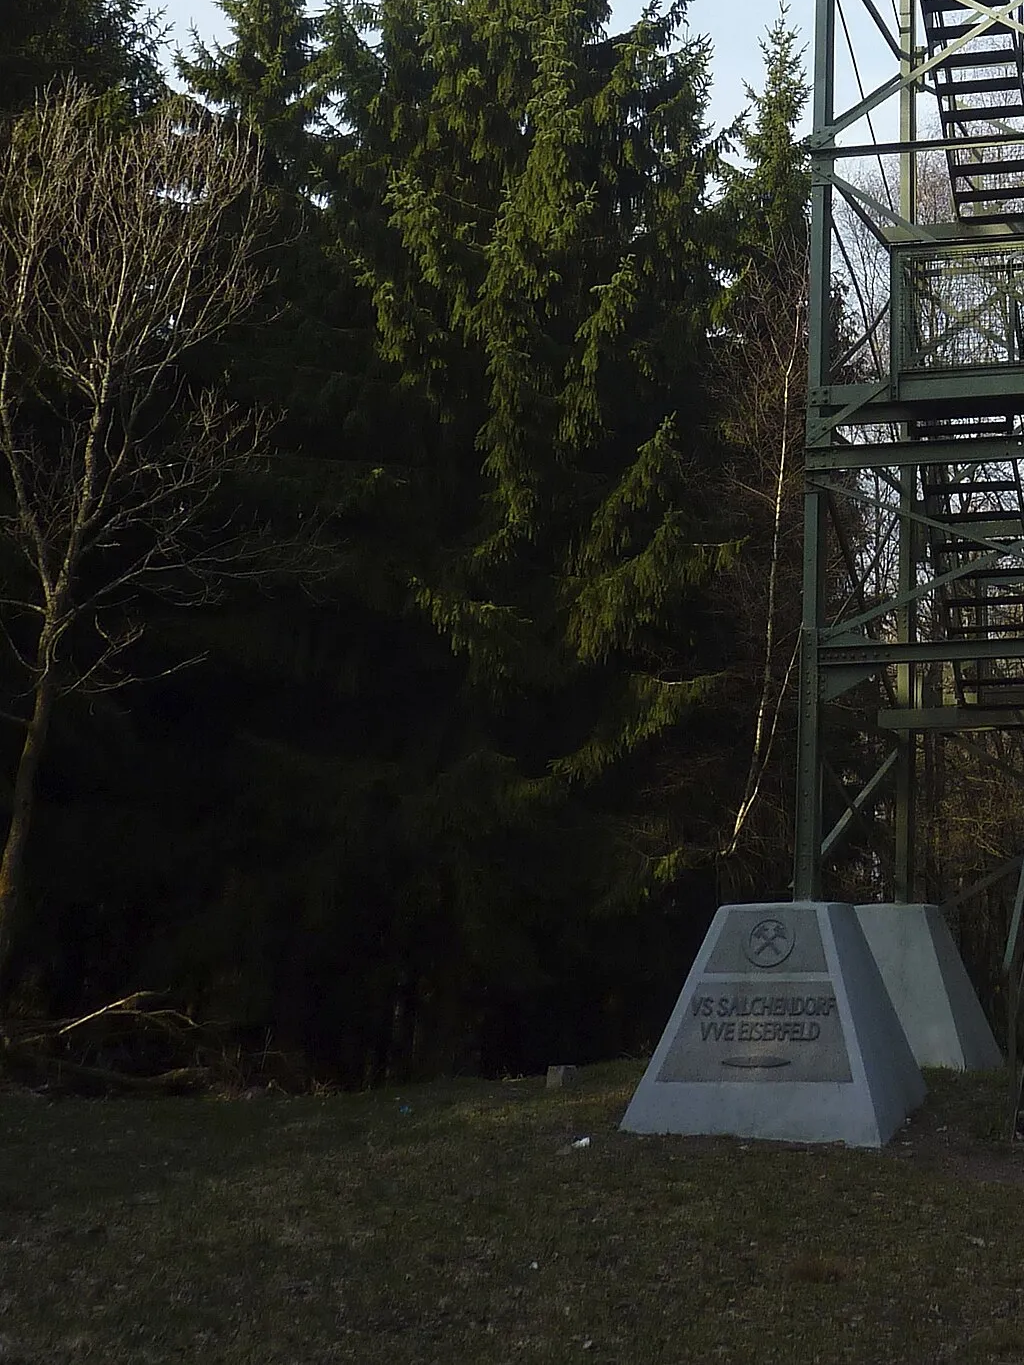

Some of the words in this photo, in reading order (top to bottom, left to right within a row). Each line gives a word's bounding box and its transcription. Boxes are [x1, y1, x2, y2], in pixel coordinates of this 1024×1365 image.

[692, 996, 713, 1016] VS
[716, 995, 837, 1016] SALCHENDORF
[700, 1021, 735, 1041] VVE
[738, 1020, 821, 1041] EISERFELD
